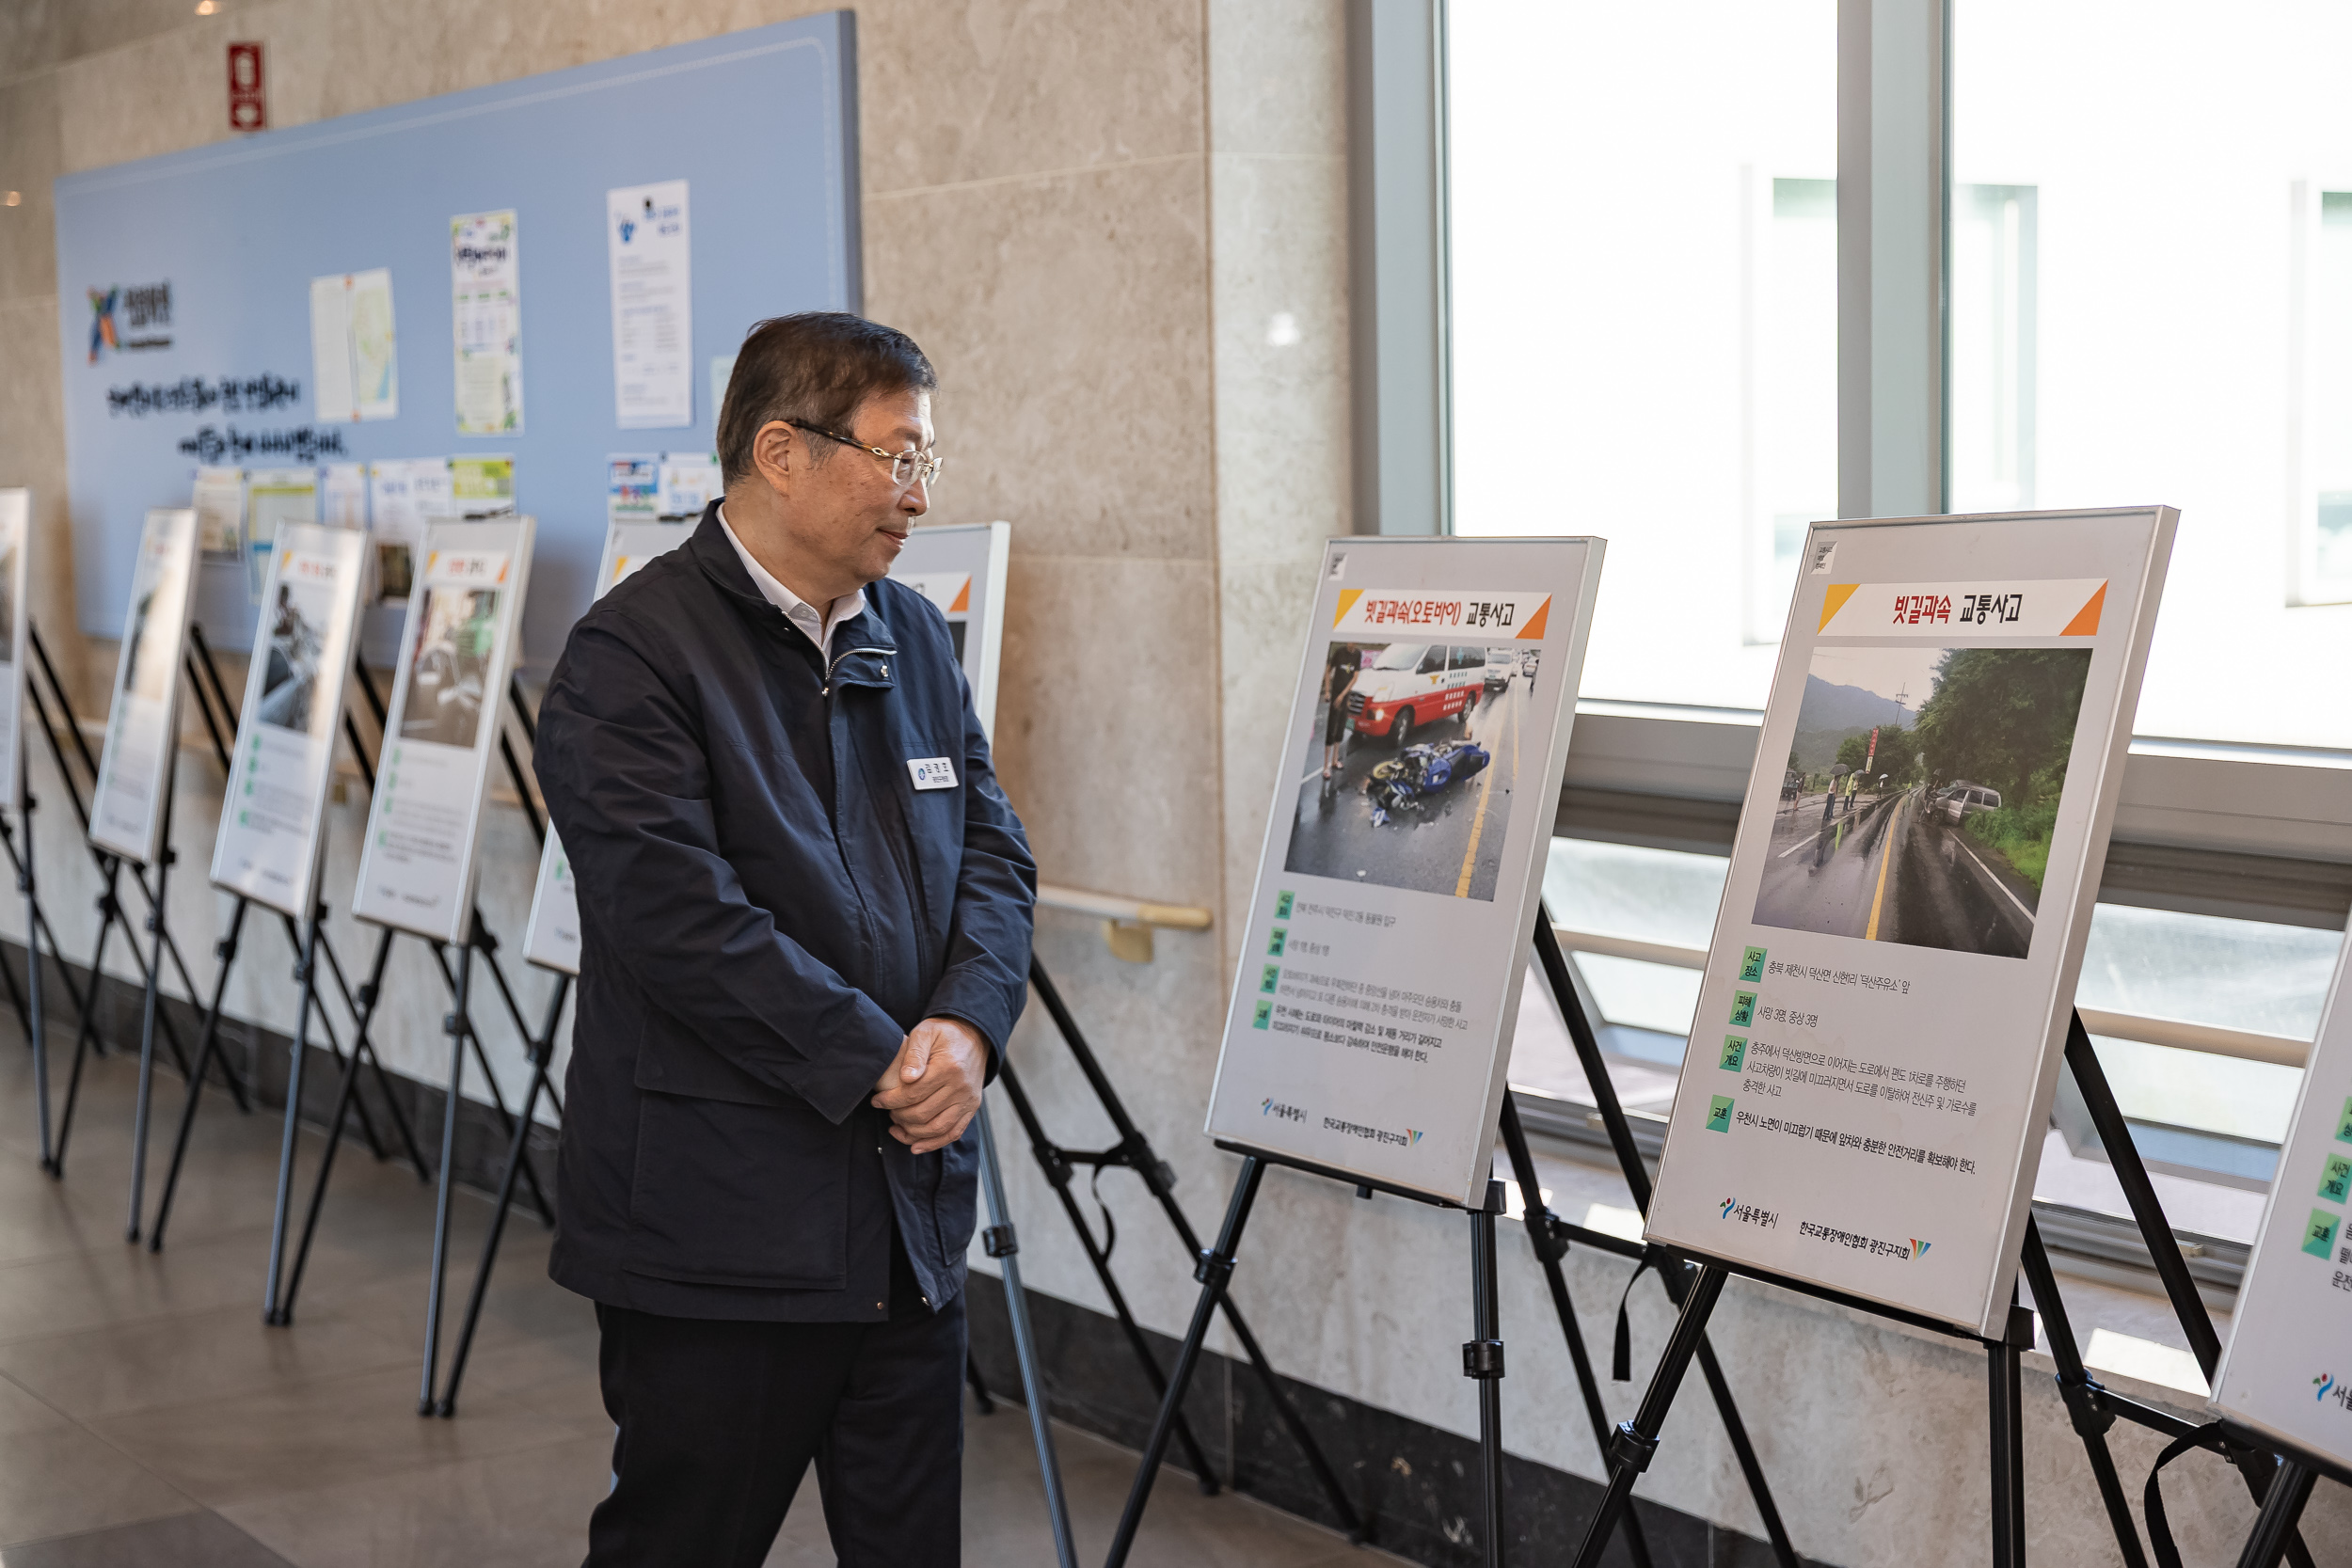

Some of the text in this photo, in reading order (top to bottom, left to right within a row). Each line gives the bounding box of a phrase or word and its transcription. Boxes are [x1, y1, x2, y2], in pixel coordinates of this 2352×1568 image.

[1364, 600, 1515, 627] 빗길과속(오토바이) 교통사고
[1892, 594, 2023, 625] 빗길과속 교통사고
[1748, 951, 1761, 962] 사고
[1745, 965, 1758, 976] 장소
[1768, 960, 1784, 974] 충북
[1784, 963, 1807, 978] 제천시
[1809, 967, 1833, 983] 덕산면
[1832, 971, 1858, 986] 신현1리
[1901, 980, 1911, 994] 앞
[1738, 995, 1752, 1007] 피해
[1735, 1009, 1749, 1022] 상황
[1756, 1006, 1772, 1020] 사망
[1788, 1010, 1804, 1025] 중상
[1804, 1013, 1818, 1027] 3명
[1727, 1039, 1742, 1053] 사건
[1724, 1054, 1739, 1066] 개요
[1750, 1041, 1966, 1093] 충주에서 덕산방면으로 이어지는 도로에서 편도 1차로를 주행하던
[1742, 1078, 1782, 1097] 충격한 사고
[1746, 1060, 1977, 1117] 사고차량이 빗길에 미끄러지면서 도로를 이탈하여 전신주 및 가로수를
[1273, 1103, 1307, 1122] 서울특별시
[1713, 1107, 1727, 1119] 교훈
[1322, 1117, 1407, 1147] 한국교통장애인협회 광진구지회
[1735, 1110, 1975, 1175] 우천시 노면이 미끄럽기 때문에 앞차와 충분한 안전거리를 확보해야 한다.
[2331, 1159, 2350, 1178] 사건
[2326, 1180, 2344, 1196] 개요
[1734, 1205, 1779, 1228] 서울특별시
[1800, 1221, 1910, 1260] 한국교통장애인협회 광진구지회
[2312, 1225, 2330, 1243] 교훈
